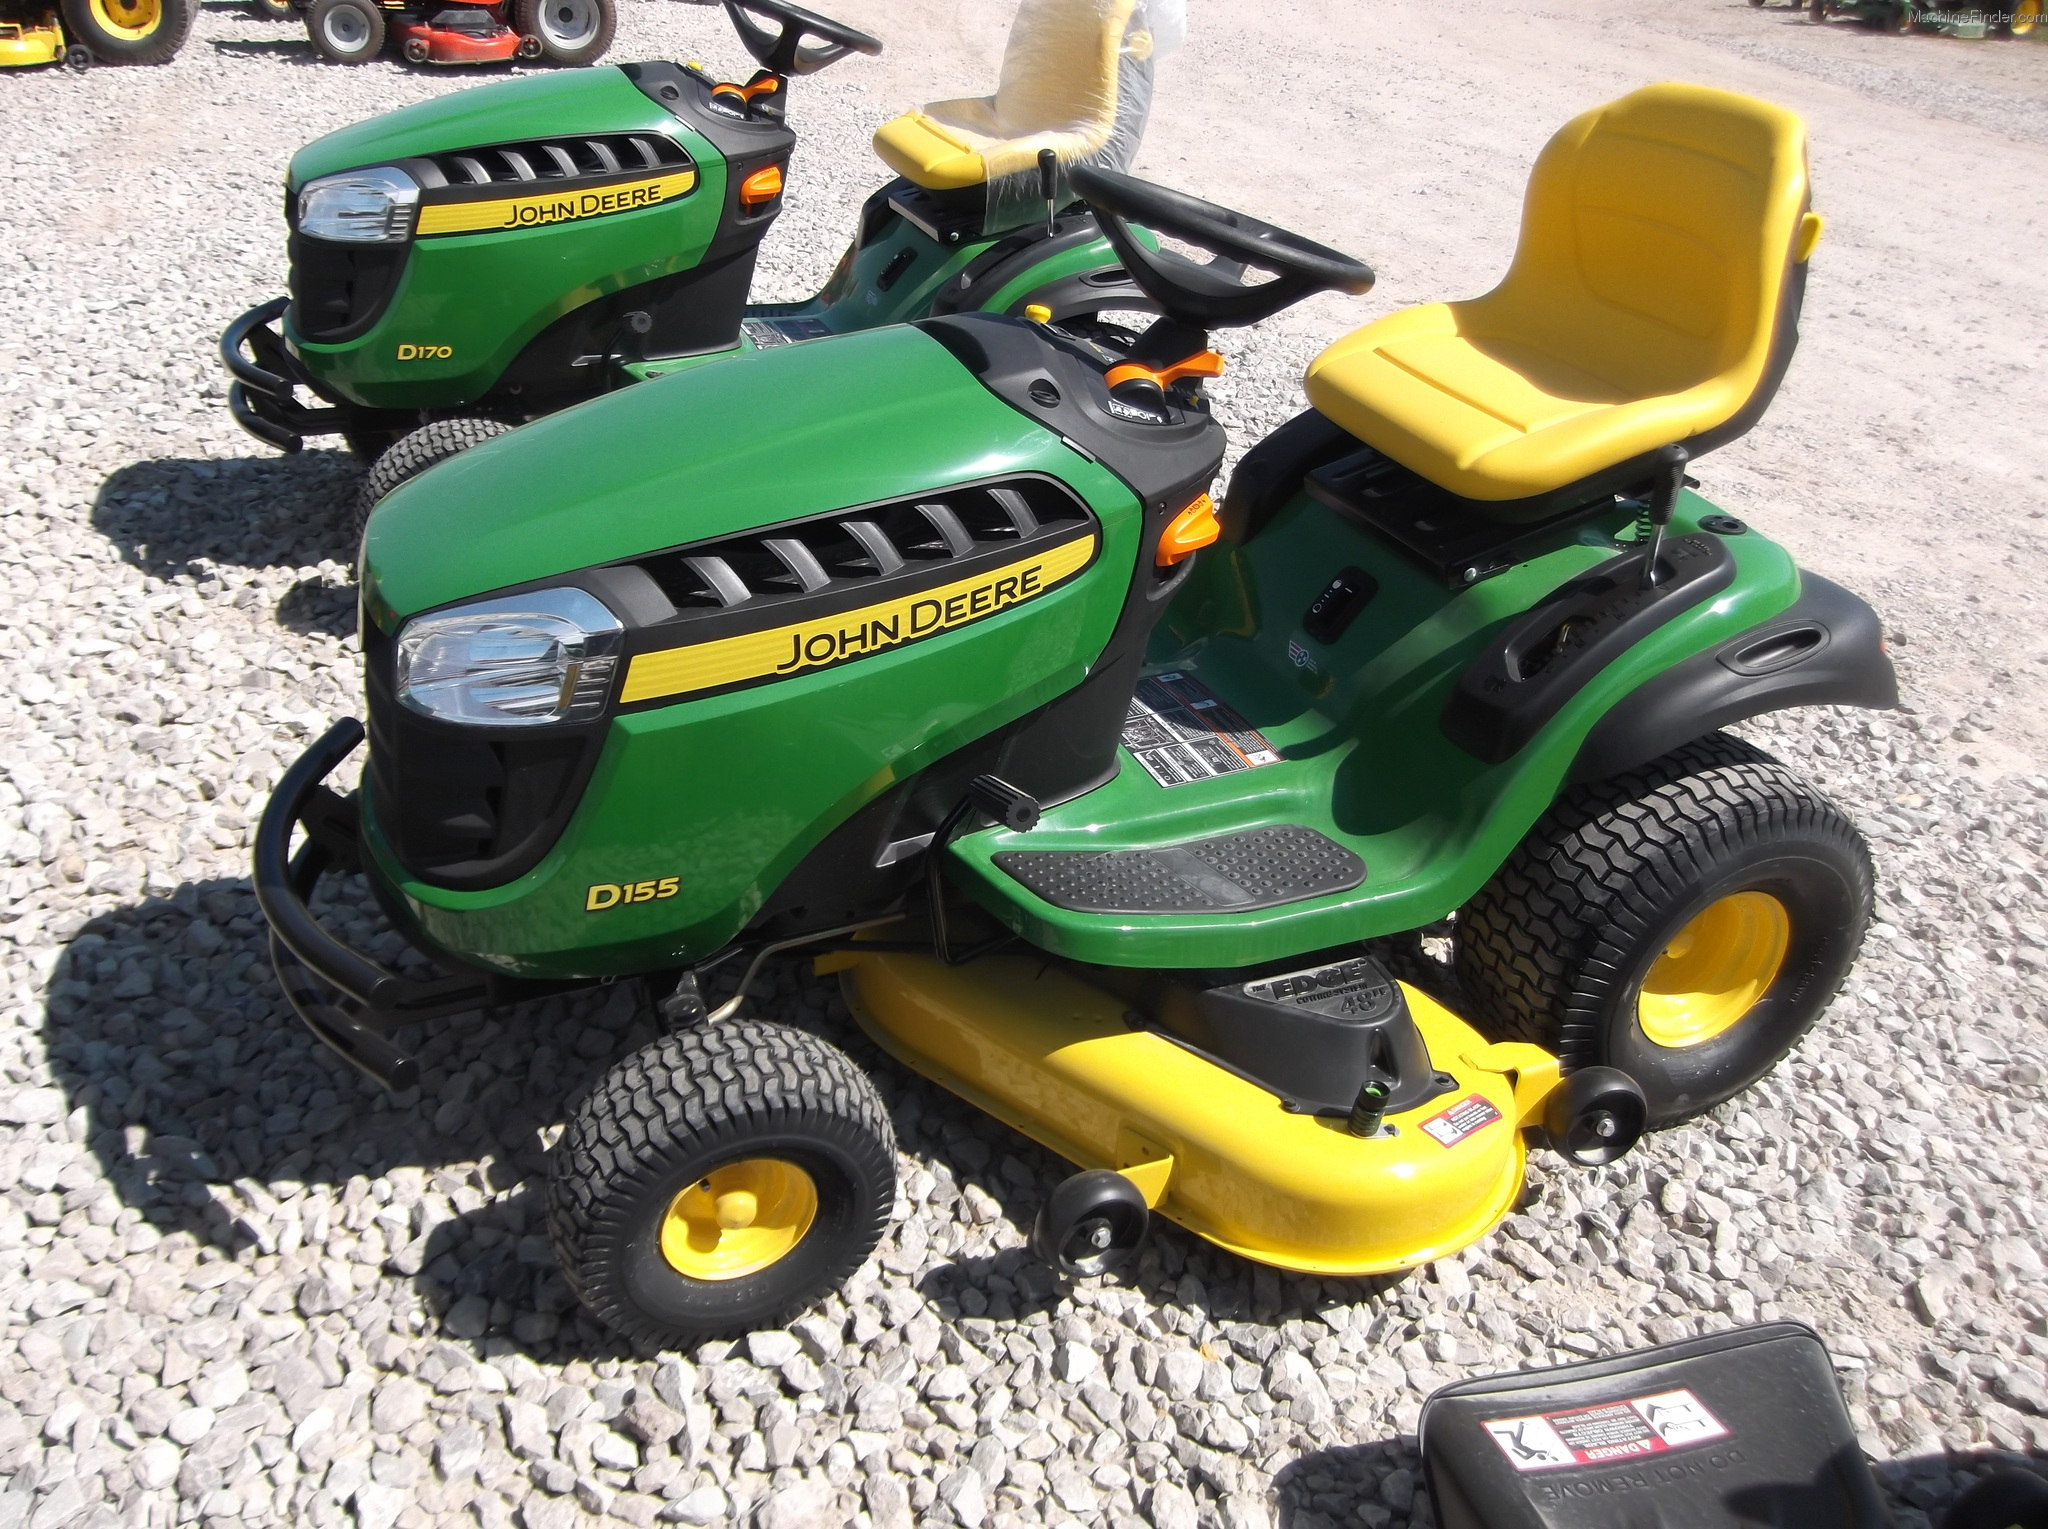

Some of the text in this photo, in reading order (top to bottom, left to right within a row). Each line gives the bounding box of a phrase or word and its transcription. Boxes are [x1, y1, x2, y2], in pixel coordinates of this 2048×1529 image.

[503, 184, 662, 226] JOHN DEERE
[396, 343, 453, 361] D170
[776, 564, 1043, 671] JOHN DEERE
[585, 876, 681, 912] D155
[1270, 962, 1366, 1001] EDGE
[1584, 1442, 1640, 1460] DANGER
[1543, 1472, 1650, 1500] REMOVE
[1654, 1460, 1706, 1484] NOT
